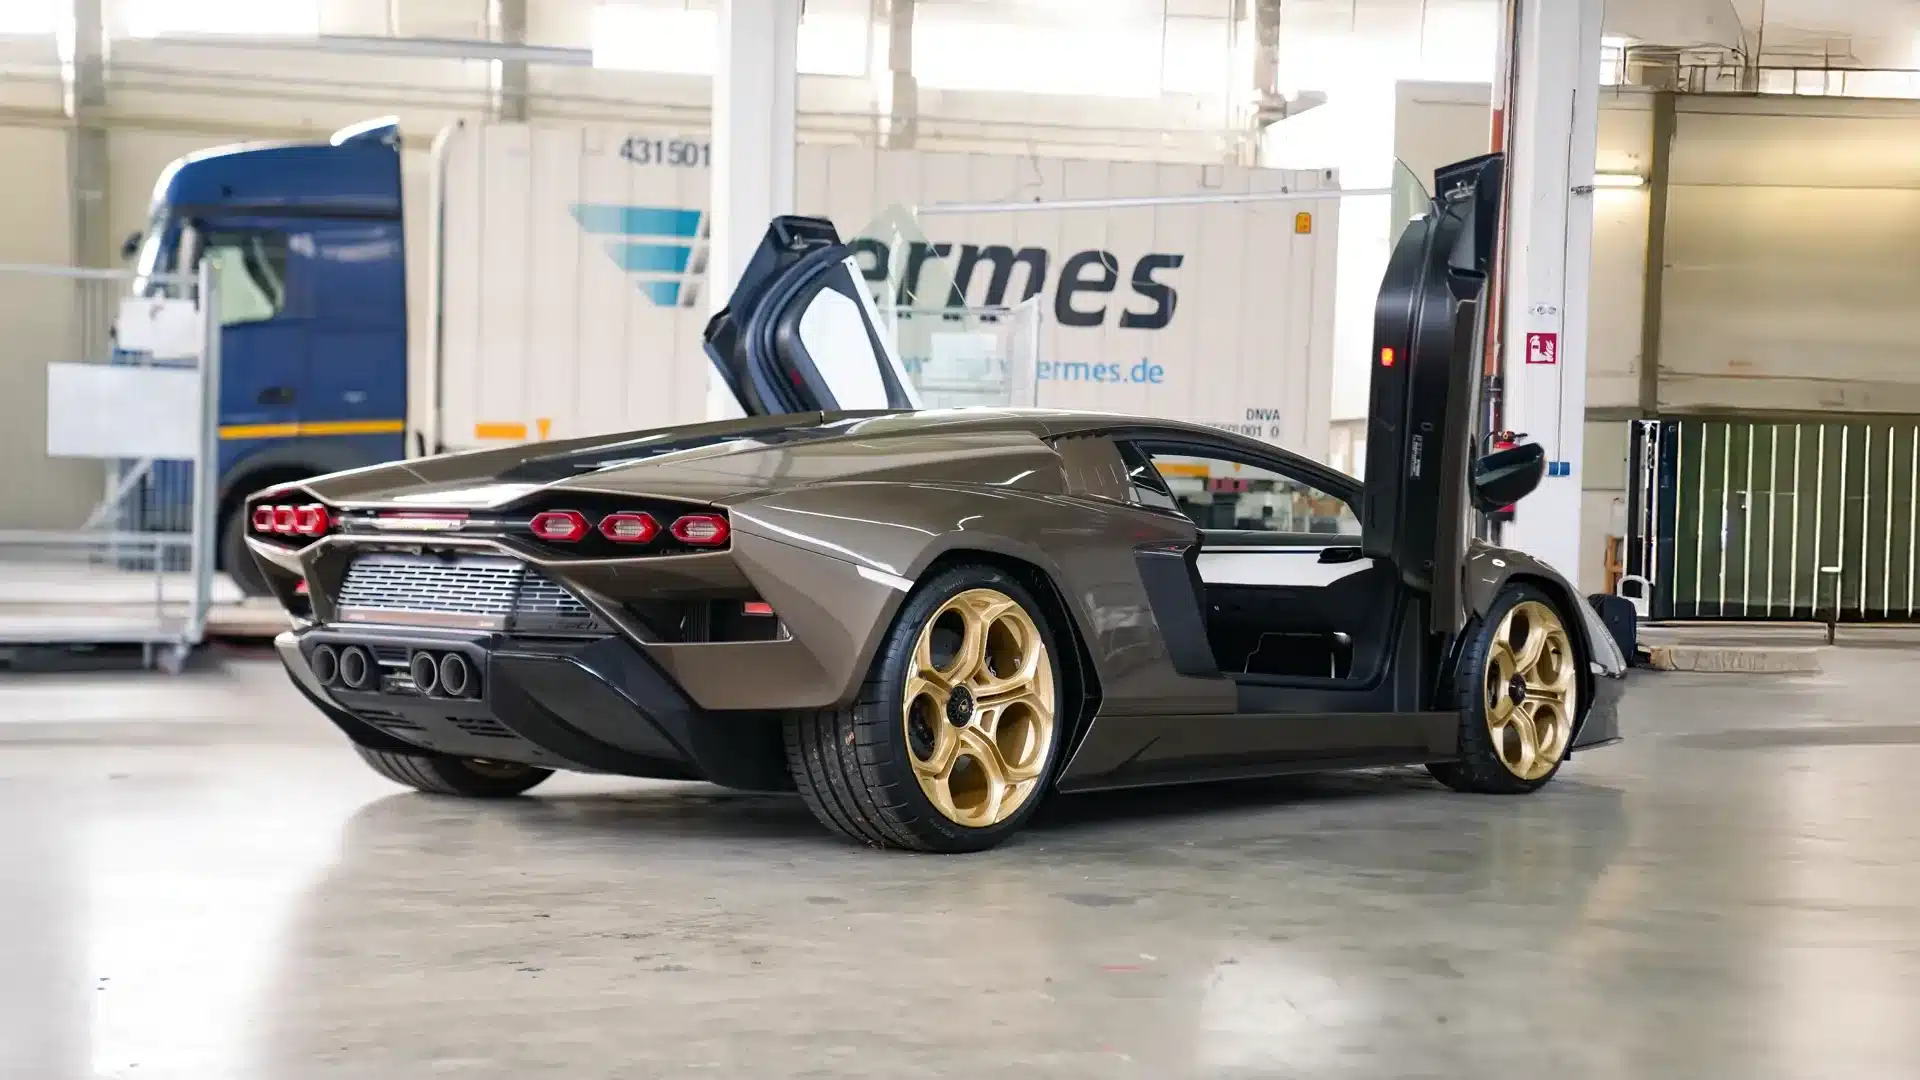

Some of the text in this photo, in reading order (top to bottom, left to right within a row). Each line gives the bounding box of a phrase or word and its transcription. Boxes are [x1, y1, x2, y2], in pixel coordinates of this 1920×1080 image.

[848, 238, 1186, 330] ermes
[1036, 357, 1165, 384] ermes.de
[1246, 408, 1280, 420] DNVA
